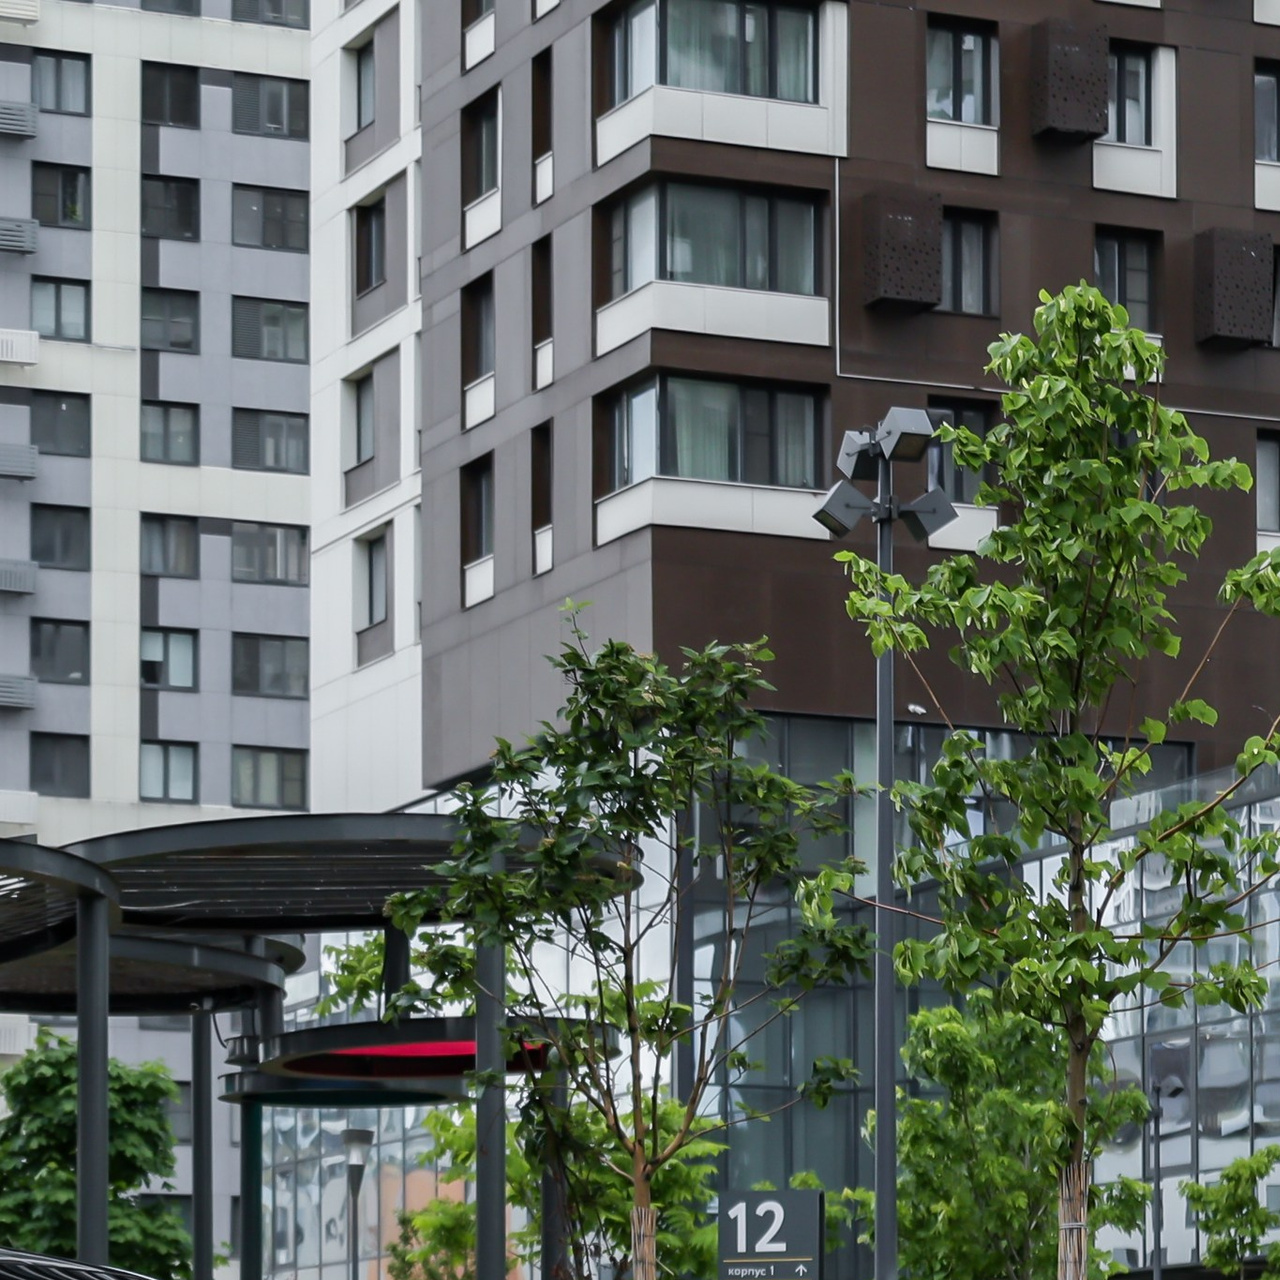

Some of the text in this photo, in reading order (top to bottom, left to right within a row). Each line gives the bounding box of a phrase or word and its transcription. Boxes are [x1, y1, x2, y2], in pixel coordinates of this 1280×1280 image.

[727, 1200, 787, 1253] 12
[728, 1265, 775, 1278] корпус 1
